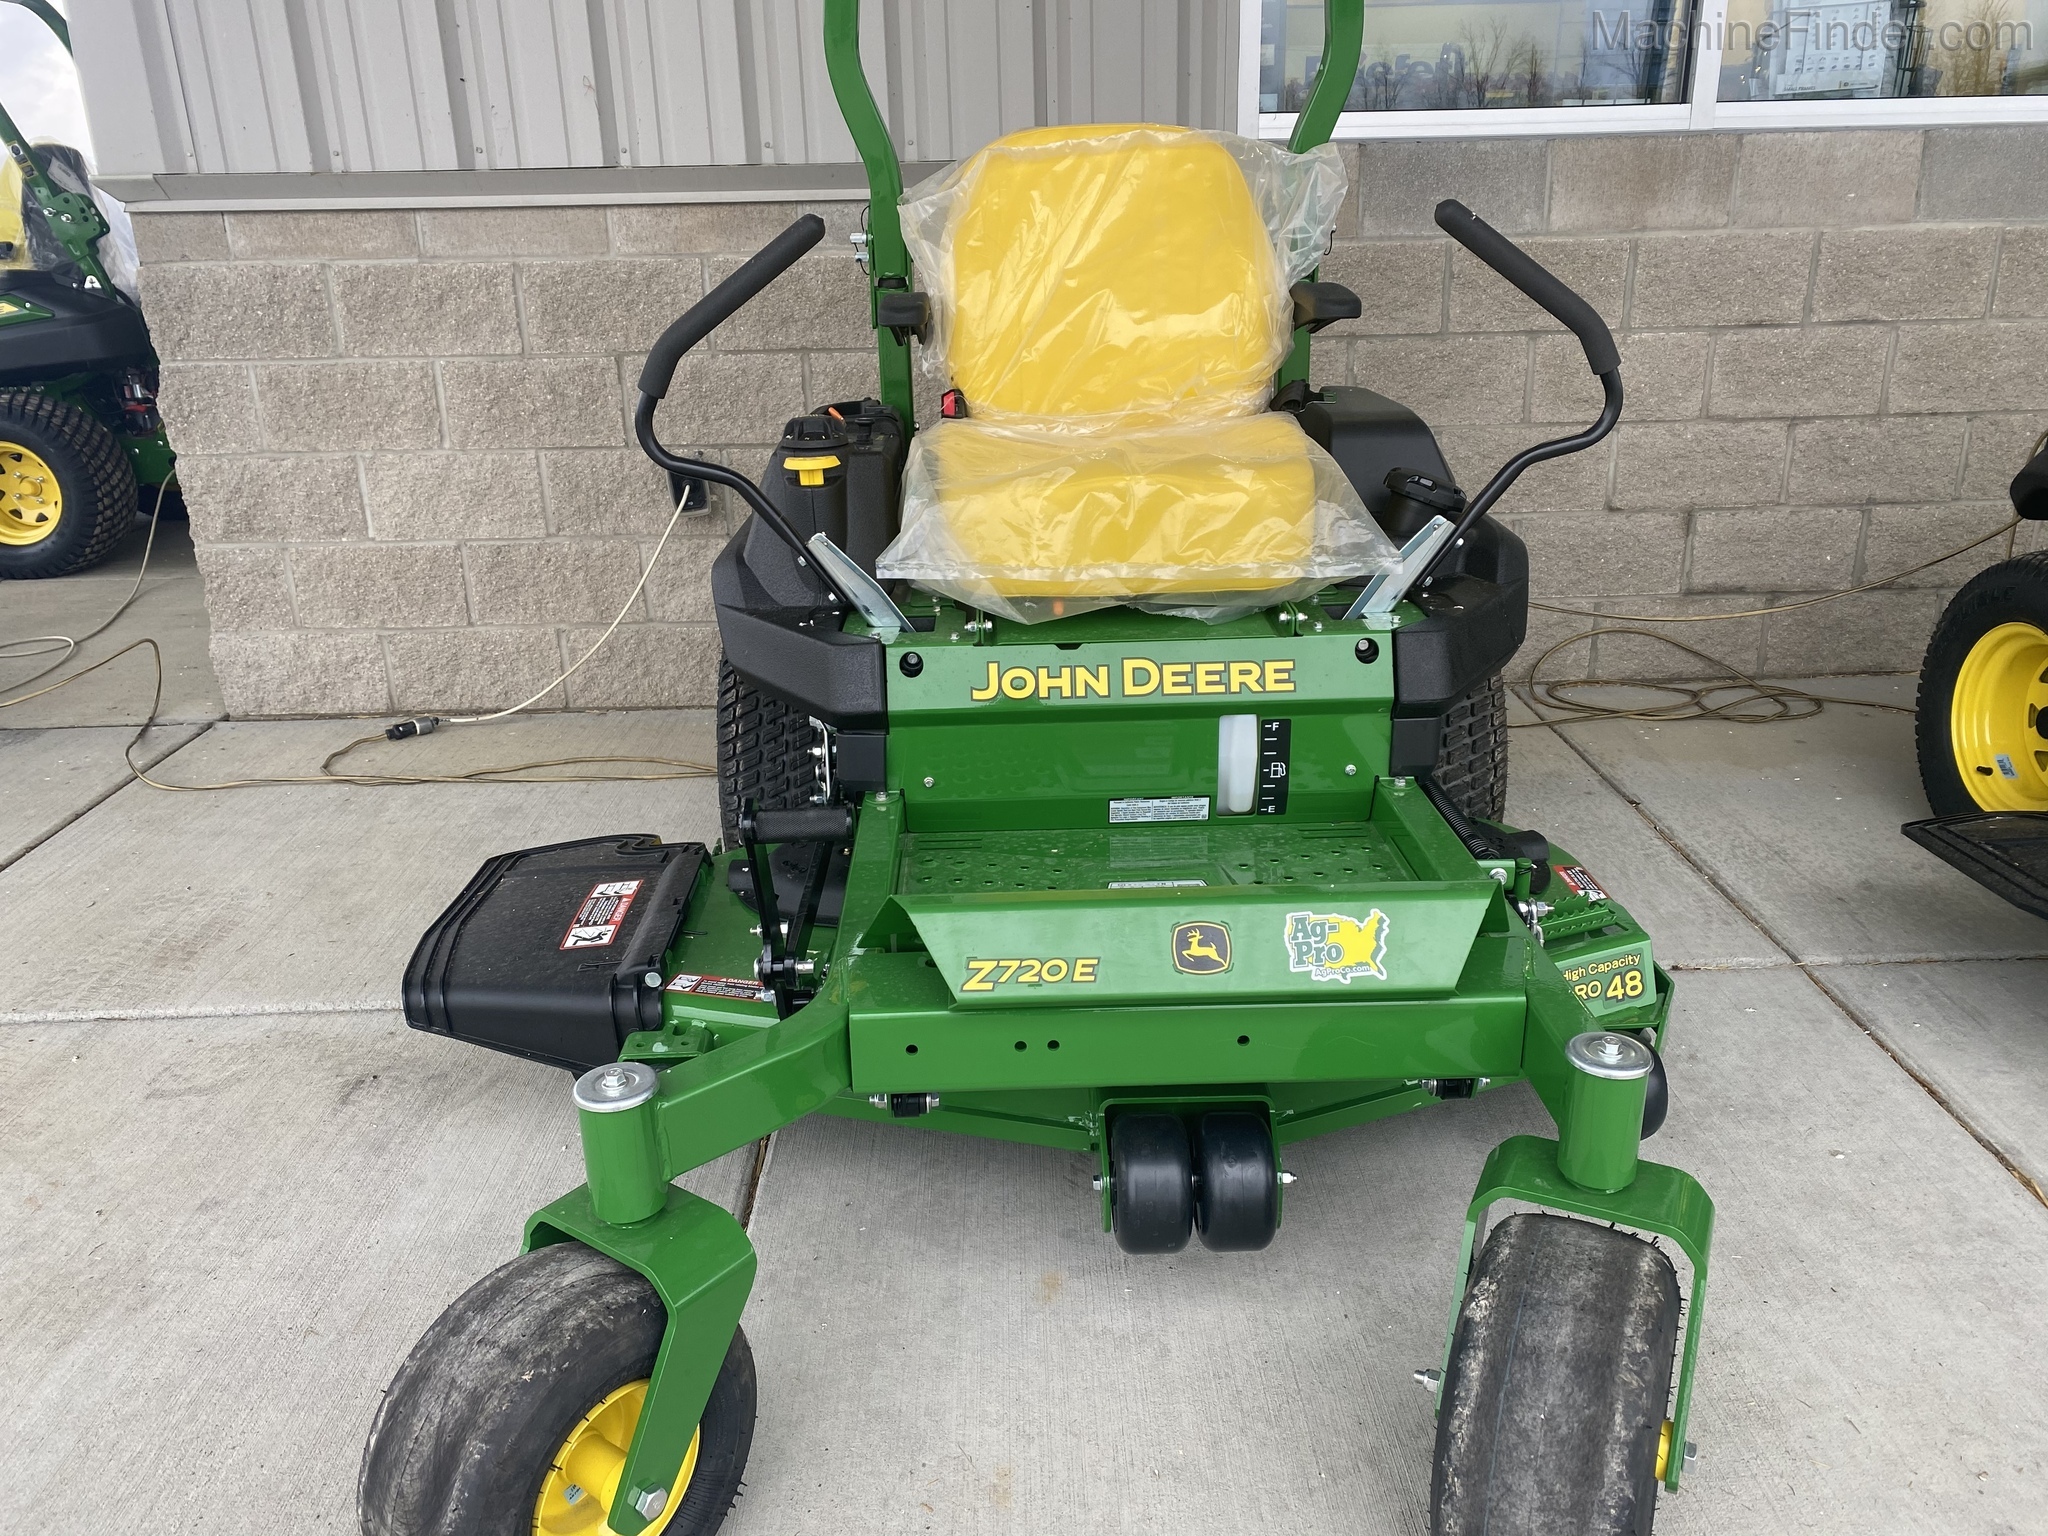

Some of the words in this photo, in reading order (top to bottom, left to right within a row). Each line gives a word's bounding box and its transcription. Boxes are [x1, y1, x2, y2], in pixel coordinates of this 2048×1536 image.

[971, 660, 1110, 702] JOHN
[1121, 657, 1296, 698] DEERE
[1293, 940, 1344, 967] Pro
[1588, 953, 1641, 975] Capacity
[1314, 965, 1371, 978] AgProCo.com
[1605, 969, 1644, 1001] 48
